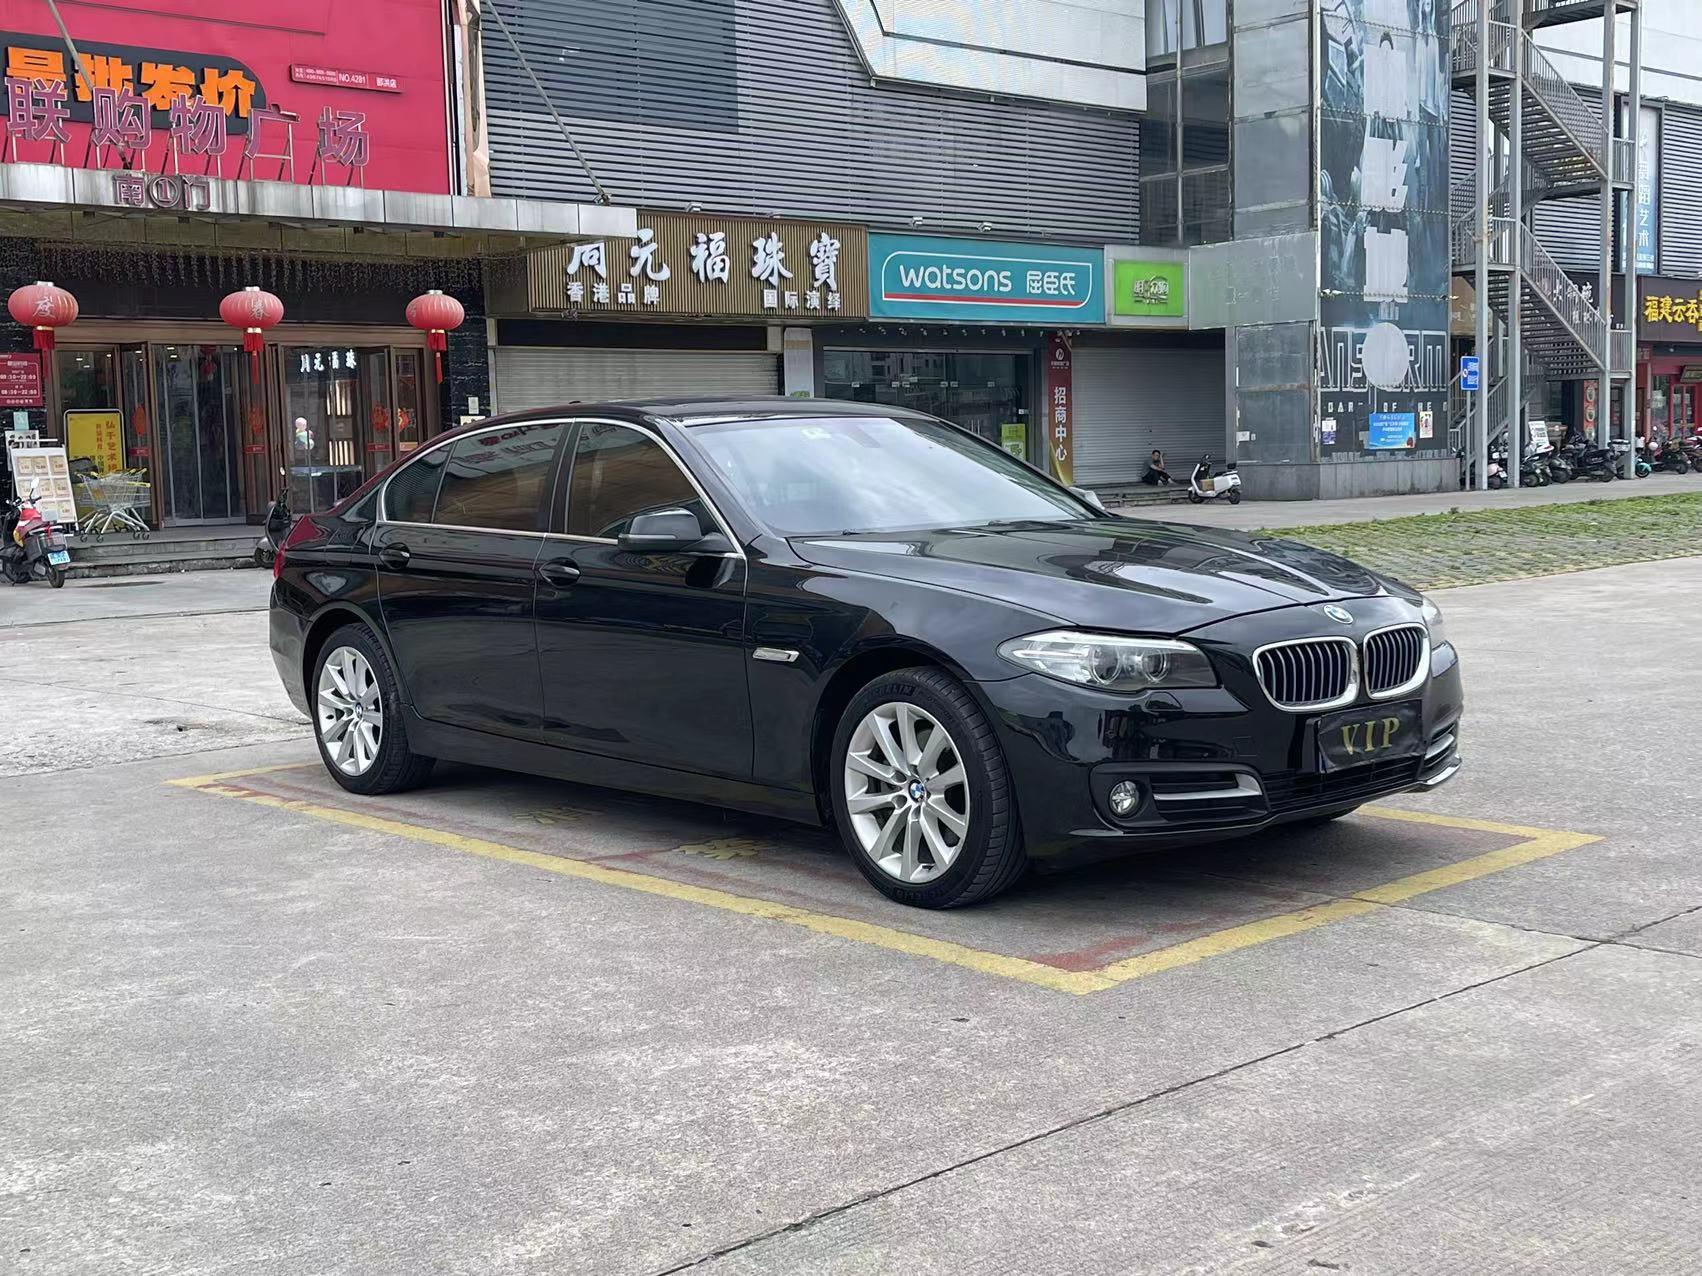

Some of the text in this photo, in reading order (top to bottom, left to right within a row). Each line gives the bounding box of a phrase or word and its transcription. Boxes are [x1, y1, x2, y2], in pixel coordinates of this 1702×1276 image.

[339, 73, 366, 84] NO.4281
[5, 77, 370, 166] 联购物广场
[900, 264, 1012, 292] watsons
[1026, 270, 1076, 295] 屈臣氏
[567, 281, 660, 305] 香港品牌
[763, 289, 841, 311] 国际演绎
[32, 295, 57, 319] 度
[250, 298, 271, 320] 春
[1643, 295, 1699, 324] 福建云吞
[1054, 386, 1067, 460] 招商中心
[1341, 717, 1400, 755] VIP
